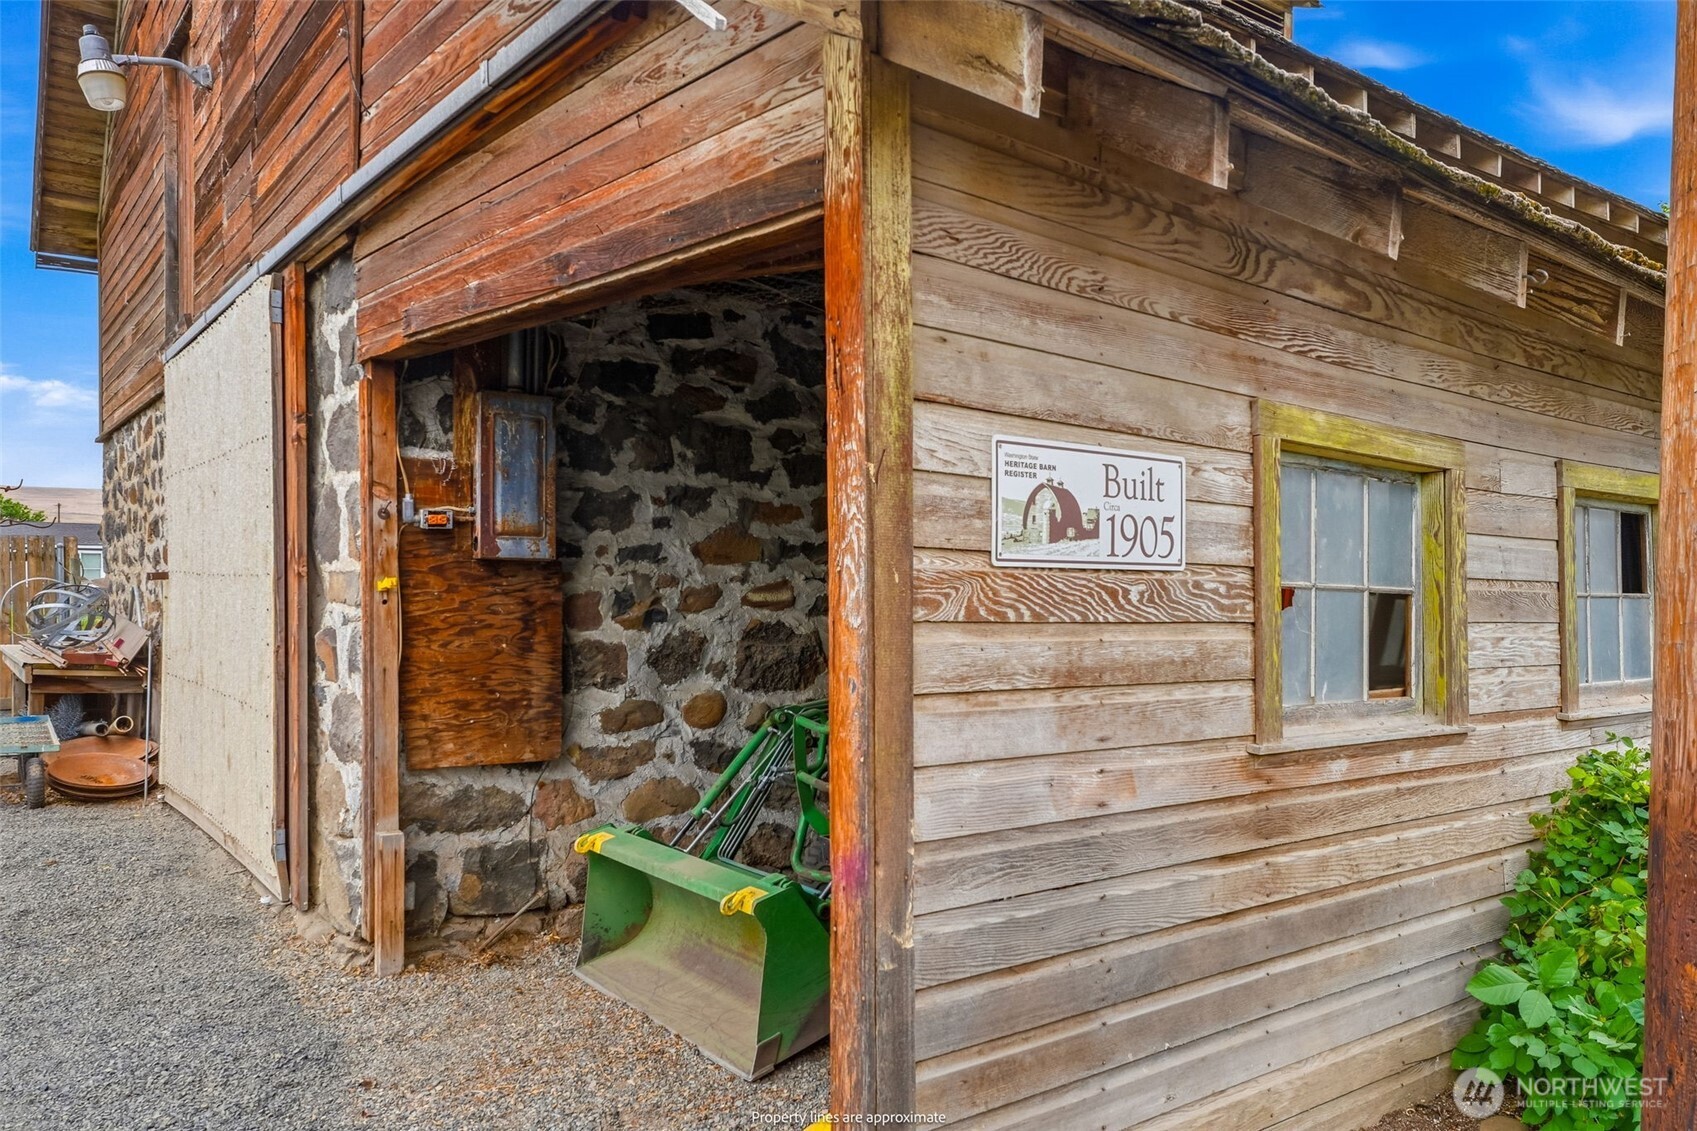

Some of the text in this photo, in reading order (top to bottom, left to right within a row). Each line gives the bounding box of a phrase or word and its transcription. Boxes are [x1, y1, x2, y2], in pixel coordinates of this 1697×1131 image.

[1004, 460, 1057, 471] HERITAGE BARN
[1004, 469, 1037, 479] REGISTER
[1102, 463, 1165, 502] Built
[1103, 502, 1121, 512] Circa
[1106, 513, 1175, 559] 1905
